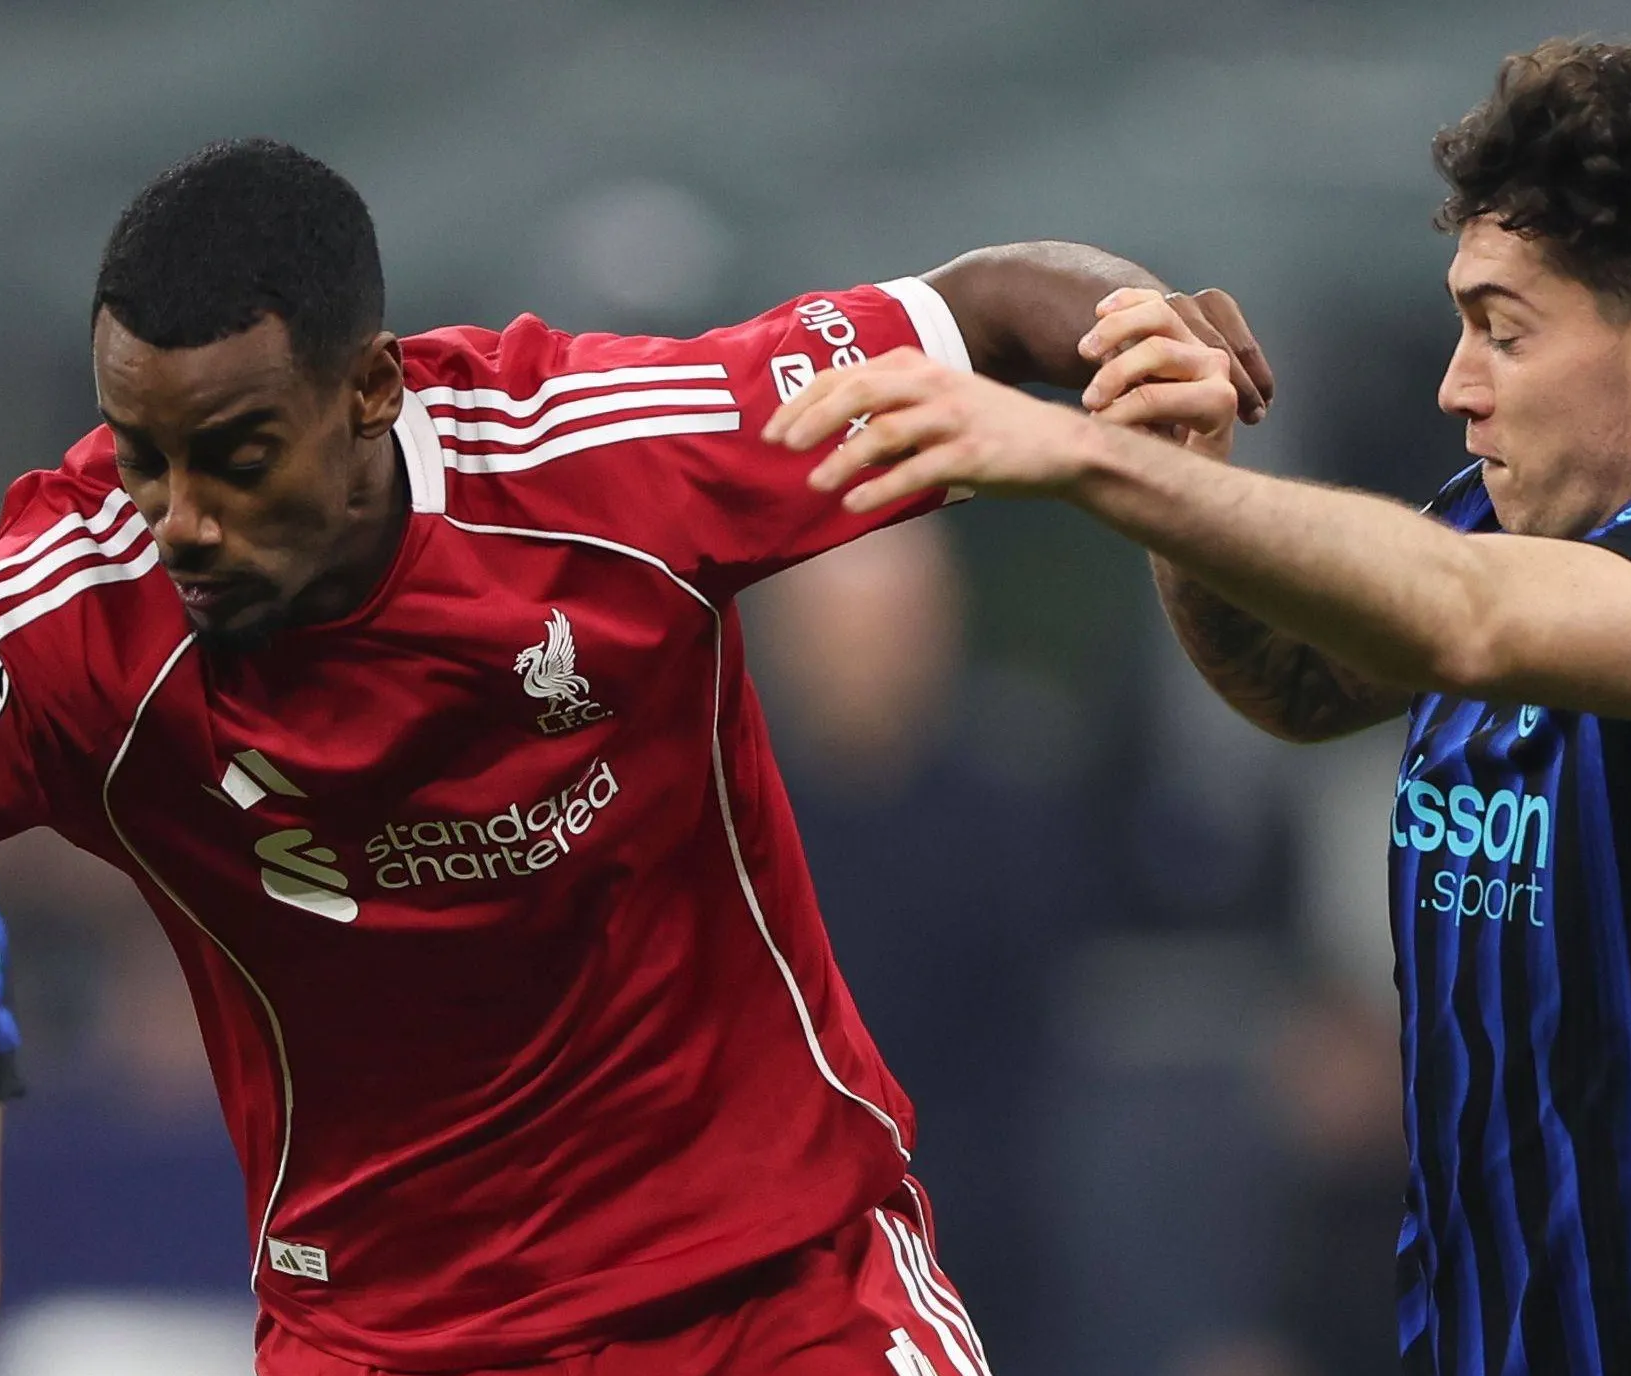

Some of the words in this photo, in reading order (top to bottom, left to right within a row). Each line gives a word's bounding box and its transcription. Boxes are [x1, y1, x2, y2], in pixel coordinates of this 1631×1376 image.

[365, 756, 600, 864] standar
[375, 762, 620, 889] chartered
[1420, 871, 1544, 927] .sport
